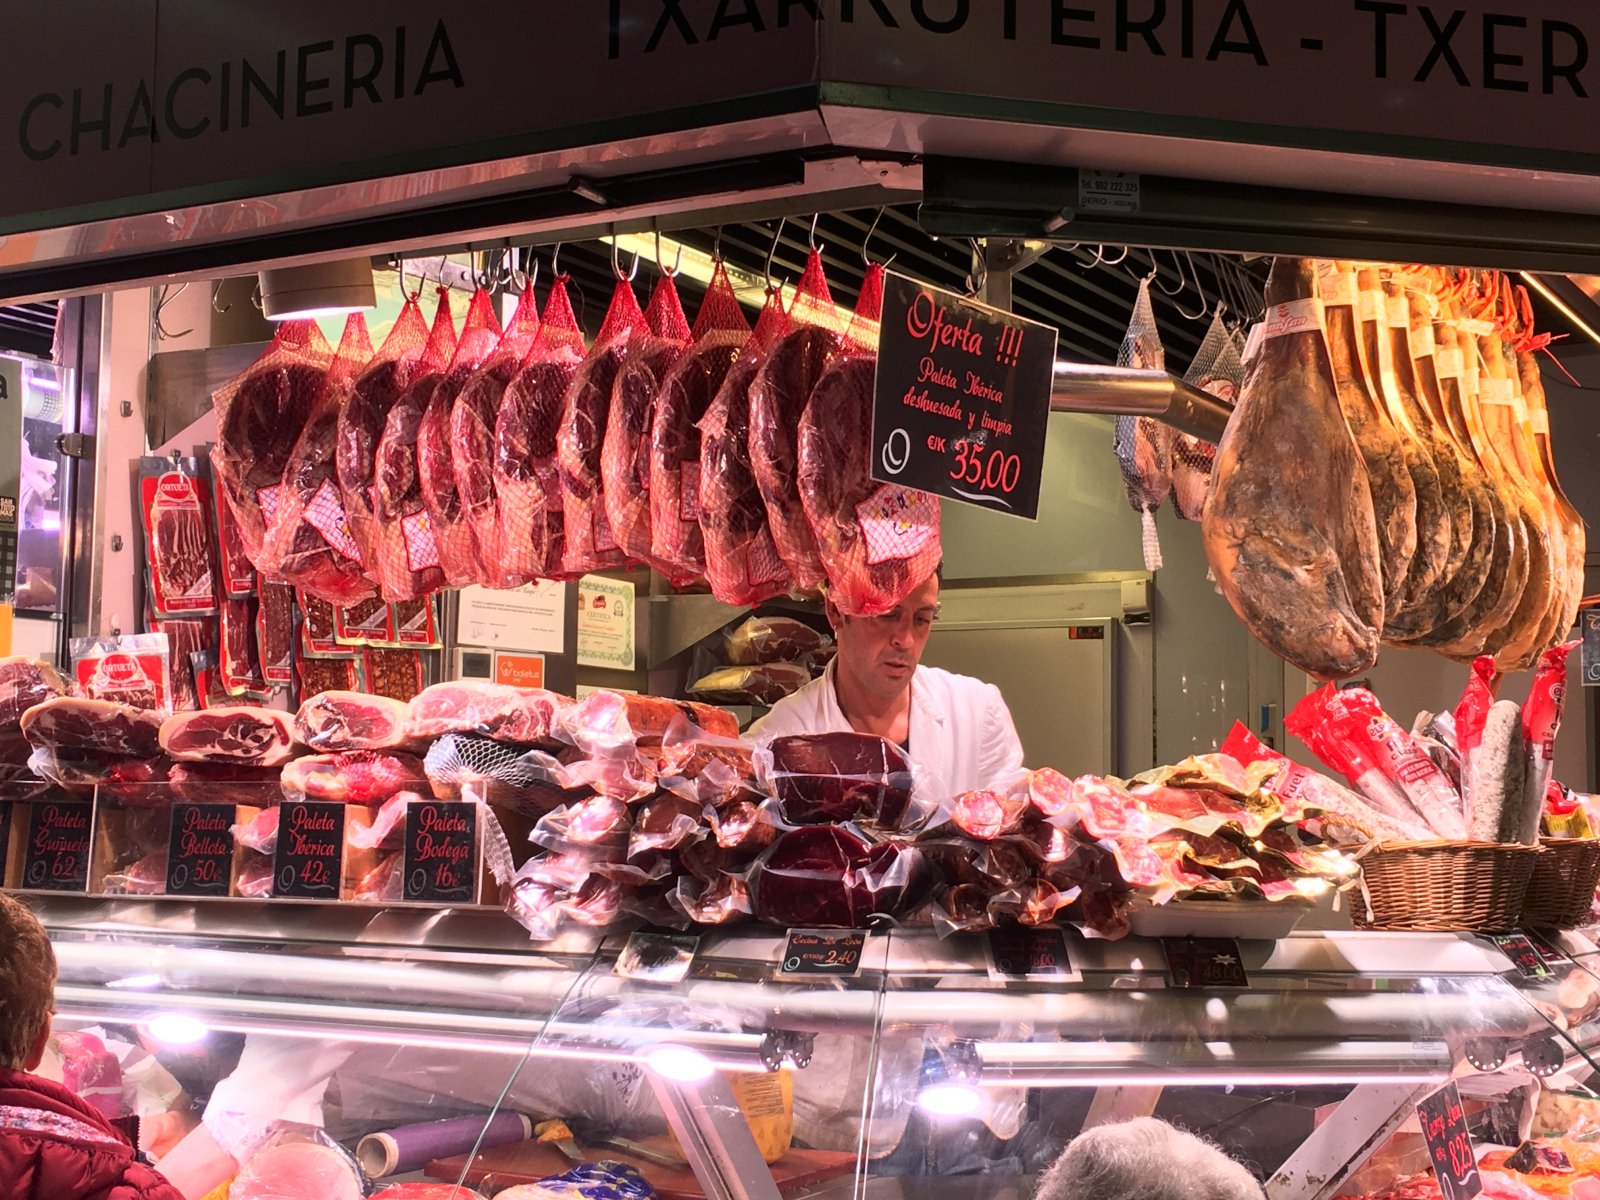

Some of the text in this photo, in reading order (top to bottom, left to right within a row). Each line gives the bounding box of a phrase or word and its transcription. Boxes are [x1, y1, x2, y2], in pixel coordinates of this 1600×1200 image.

[18, 17, 466, 161] CHACINERIA
[907, 291, 1024, 368] Oferta !!!
[917, 356, 958, 389] Paleta
[903, 386, 1013, 438] deshuesada y limpia
[949, 439, 1021, 493] 35,00
[512, 668, 540, 679] boletus
[1282, 772, 1305, 799] Fuet
[38, 805, 87, 830] Paleta
[181, 806, 227, 833] Paleta
[288, 805, 336, 833] Paleta
[416, 805, 467, 834] Paleta
[178, 831, 227, 858] Bellota
[414, 832, 470, 865] Bodega
[824, 949, 857, 965] 2,40
